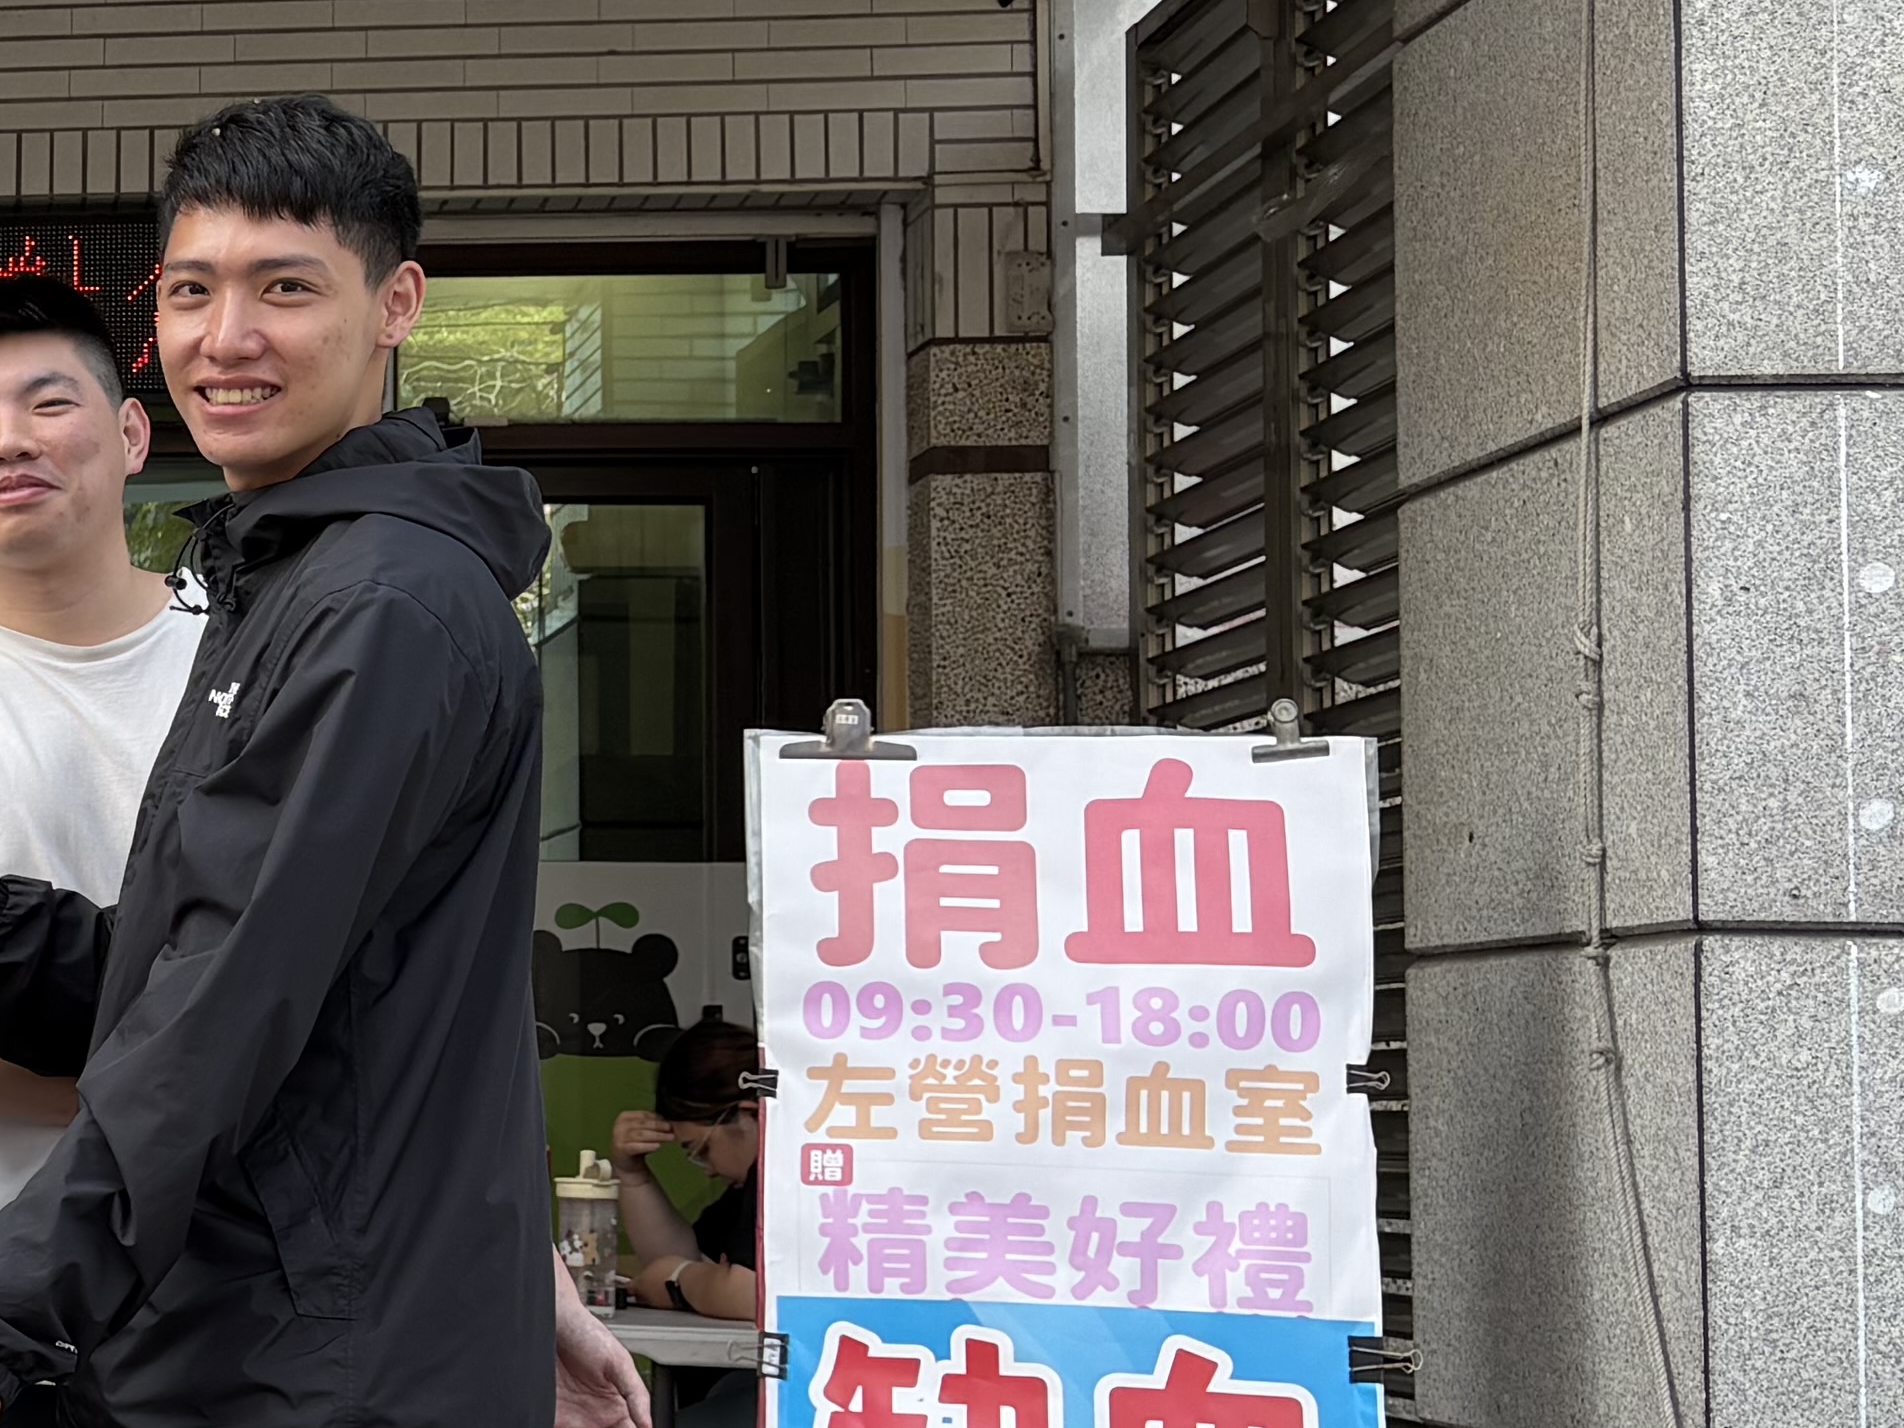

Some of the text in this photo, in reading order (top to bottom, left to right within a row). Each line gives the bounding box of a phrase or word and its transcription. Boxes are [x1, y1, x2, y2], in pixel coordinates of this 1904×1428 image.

[808, 757, 1316, 970] 捐血
[802, 981, 1320, 1052] 09:30-18:00
[803, 1052, 1322, 1156] 左營捐血室
[817, 1187, 1314, 1314] 精美好禮
